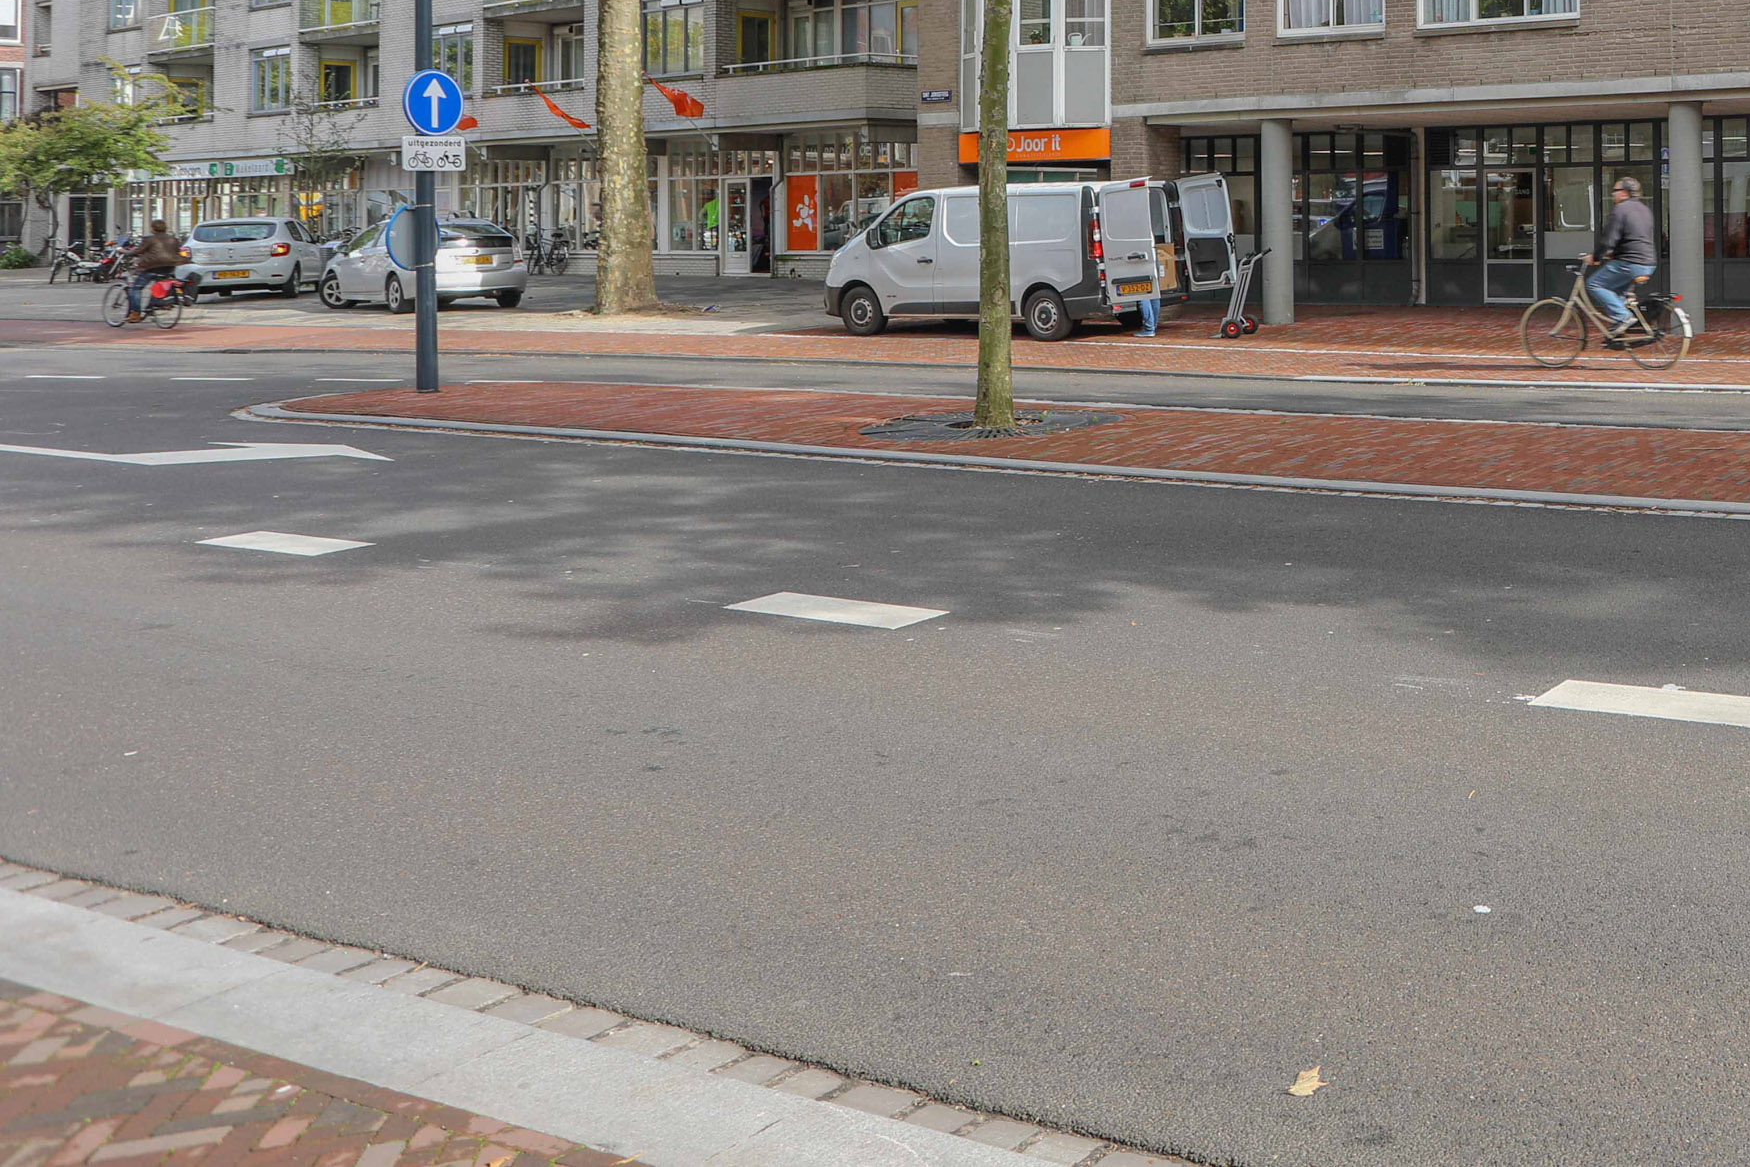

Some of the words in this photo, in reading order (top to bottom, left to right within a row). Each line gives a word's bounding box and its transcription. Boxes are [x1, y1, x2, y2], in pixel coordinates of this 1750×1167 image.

[407, 140, 462, 153] uitgezonderd
[1016, 135, 1048, 153] Joor
[1051, 134, 1061, 151] it
